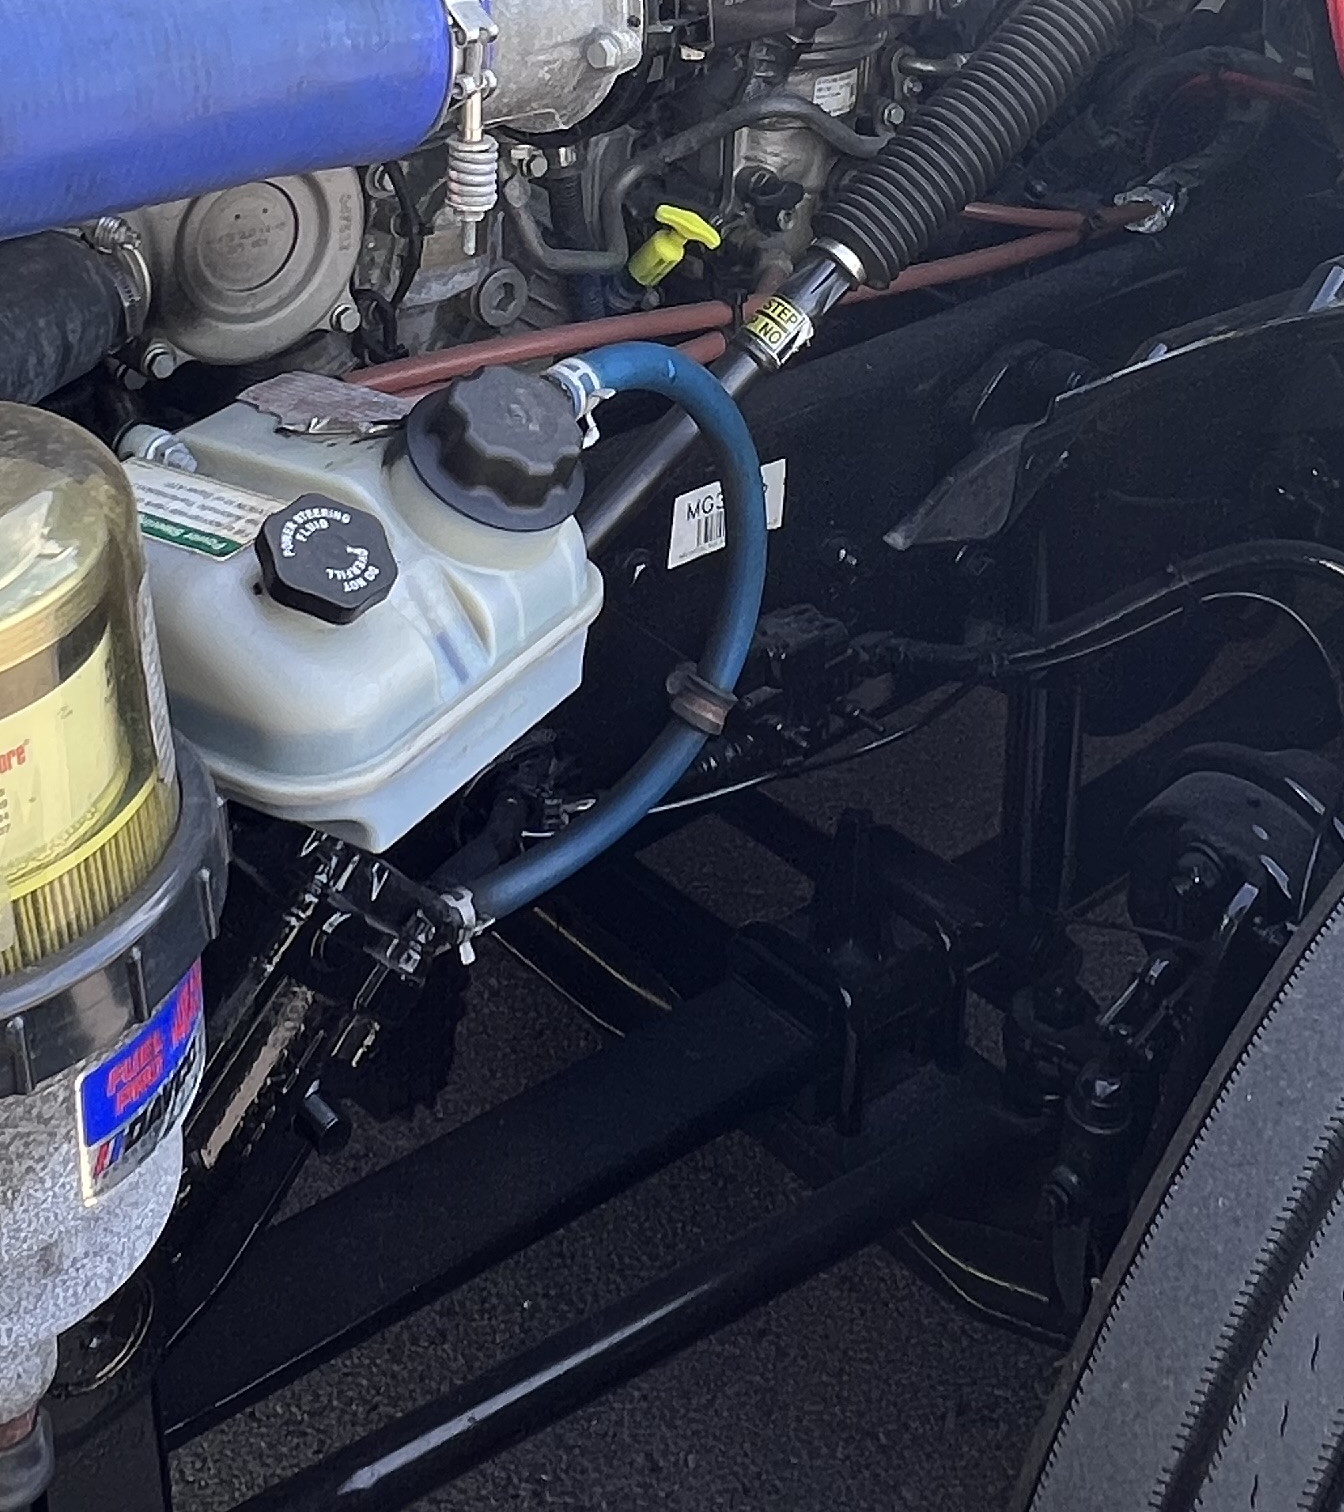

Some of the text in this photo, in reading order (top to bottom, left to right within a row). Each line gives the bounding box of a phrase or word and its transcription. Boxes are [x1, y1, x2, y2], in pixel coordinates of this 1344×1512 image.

[762, 298, 798, 325] STEP
[759, 322, 782, 345] NO
[292, 507, 352, 524] STEERING
[295, 518, 330, 542] FLUID
